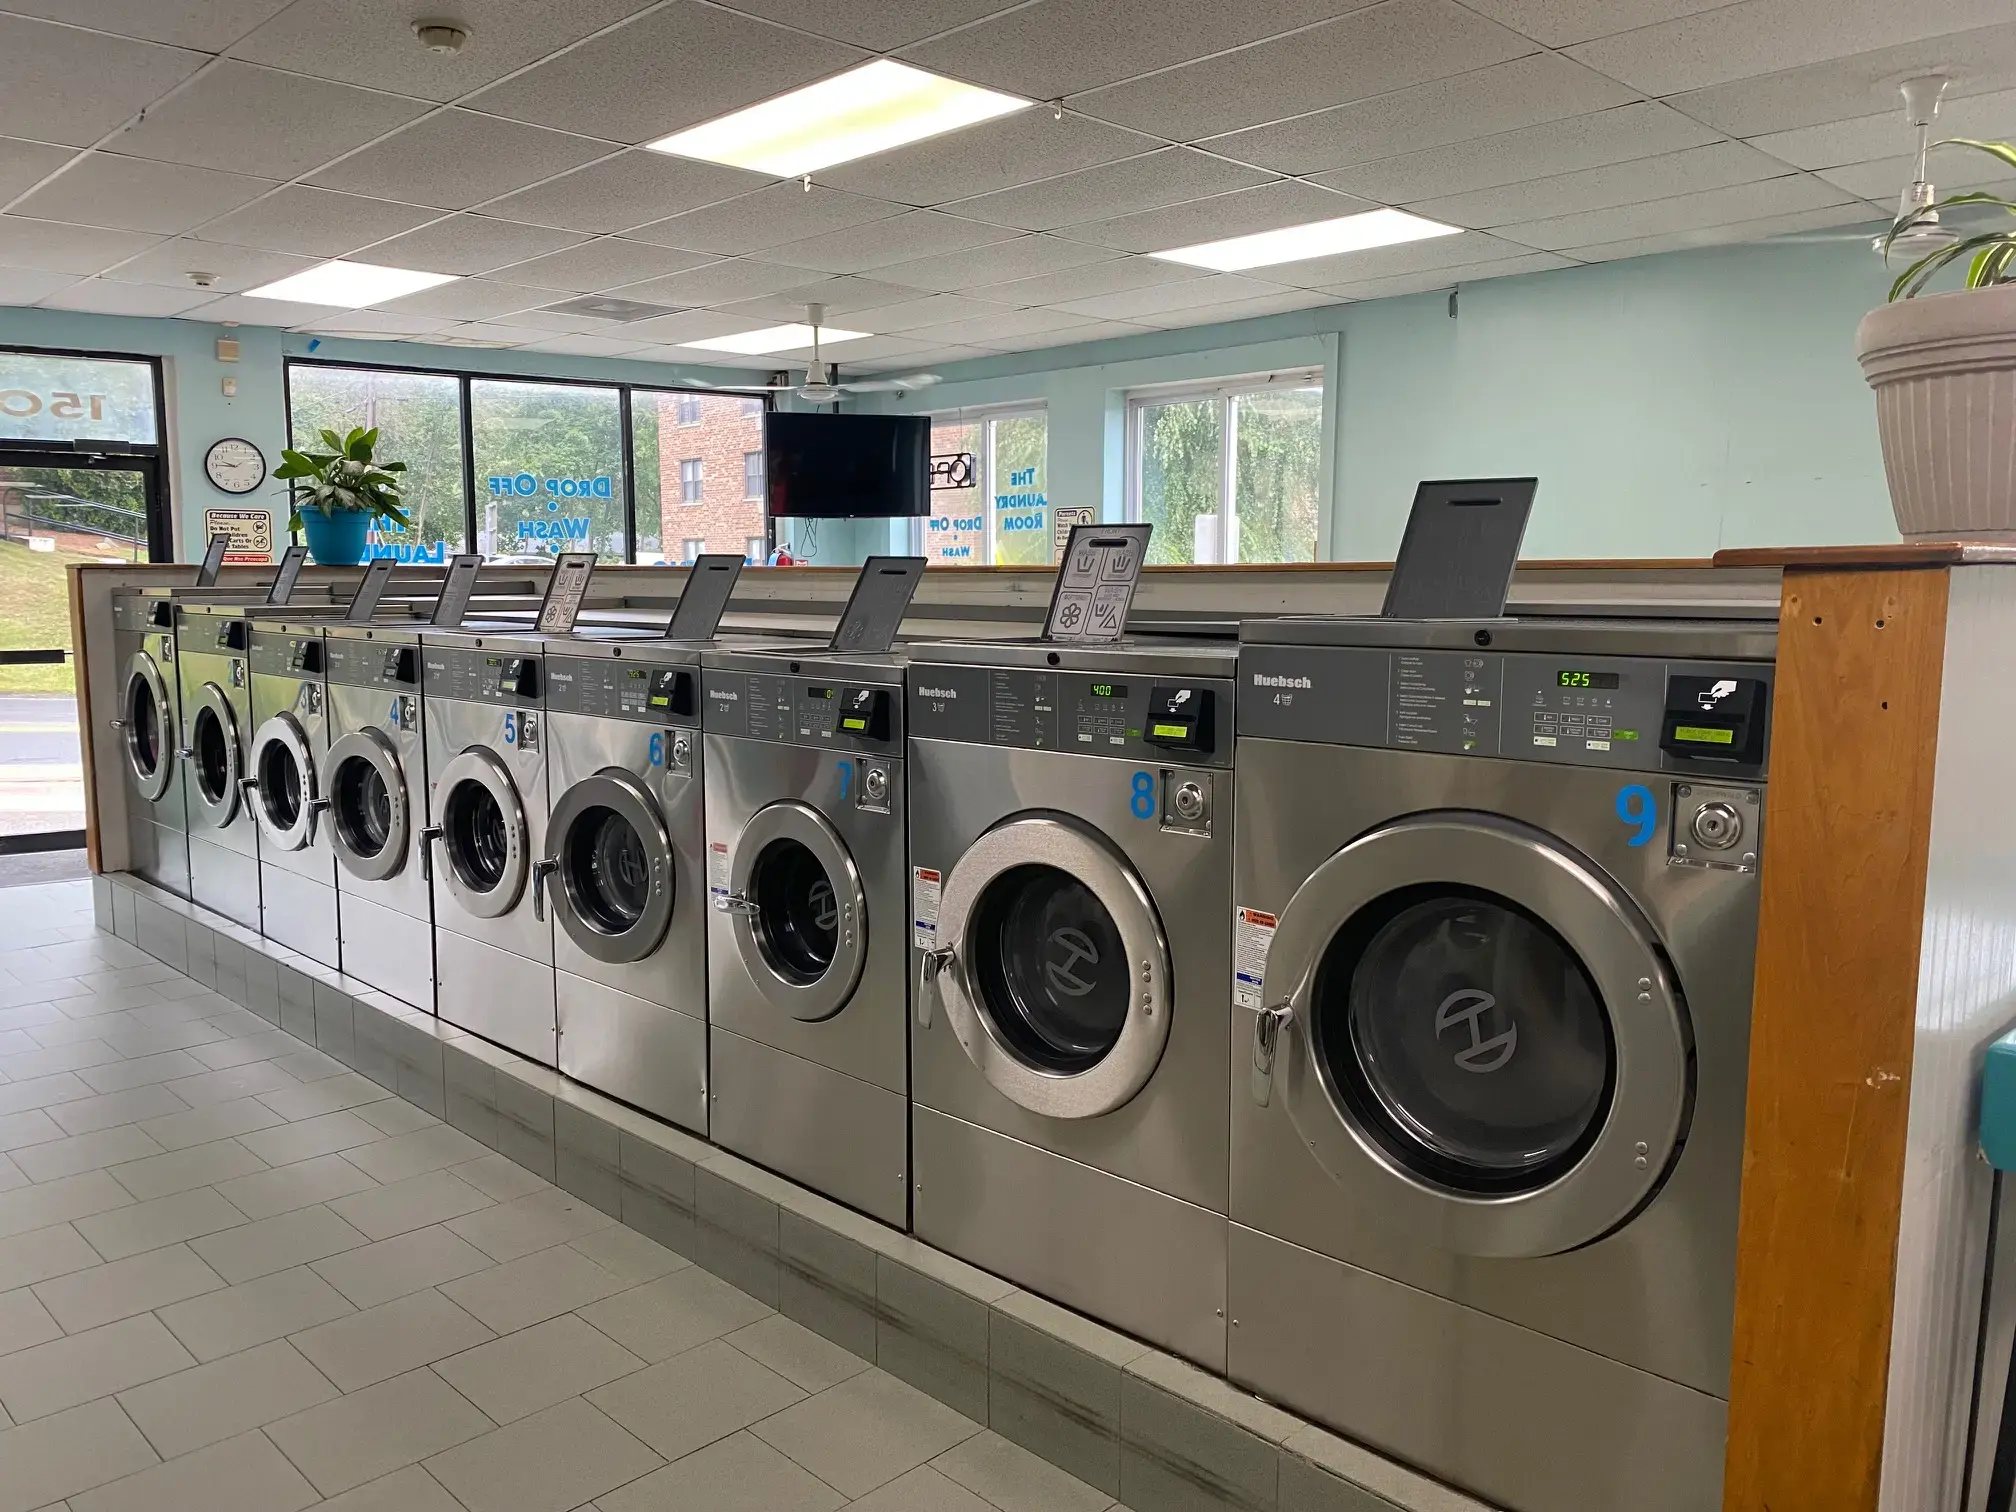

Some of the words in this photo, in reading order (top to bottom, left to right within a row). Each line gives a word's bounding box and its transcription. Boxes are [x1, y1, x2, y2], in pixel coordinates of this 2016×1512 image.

[1253, 673, 1312, 689] Huebsch
[1561, 672, 1590, 687] 525
[709, 689, 738, 701] Huebsch
[918, 686, 957, 699] Huebsch
[1093, 685, 1112, 696] 400
[932, 702, 937, 712] 3
[1273, 694, 1280, 705] 4
[390, 697, 399, 725] 4
[505, 713, 515, 744] 5
[649, 732, 663, 767] 6
[837, 761, 852, 799] 7
[1130, 771, 1155, 820] 8
[1615, 784, 1656, 847] 9
